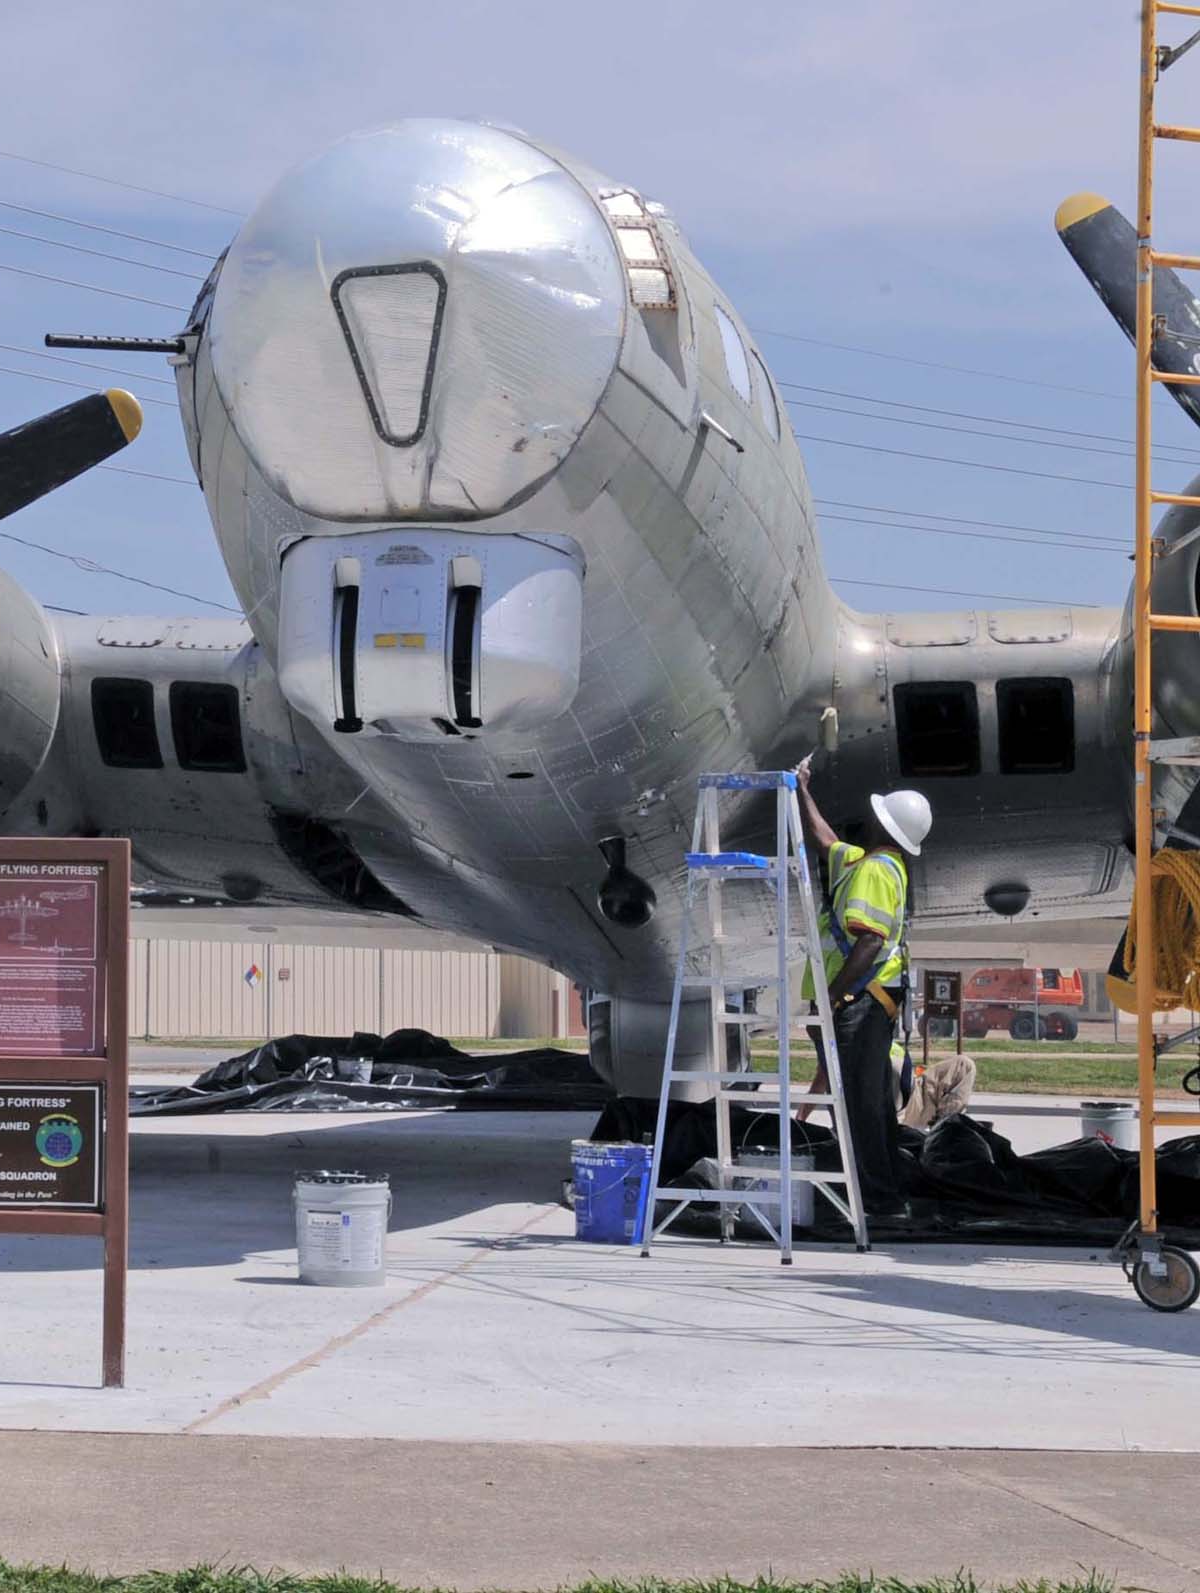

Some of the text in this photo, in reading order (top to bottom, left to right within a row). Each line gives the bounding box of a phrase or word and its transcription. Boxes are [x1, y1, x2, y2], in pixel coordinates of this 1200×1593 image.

[41, 865, 104, 876] FORTRESS"
[8, 1097, 71, 1109] FORTRESS"
[0, 1171, 57, 1181] SQUADRON
